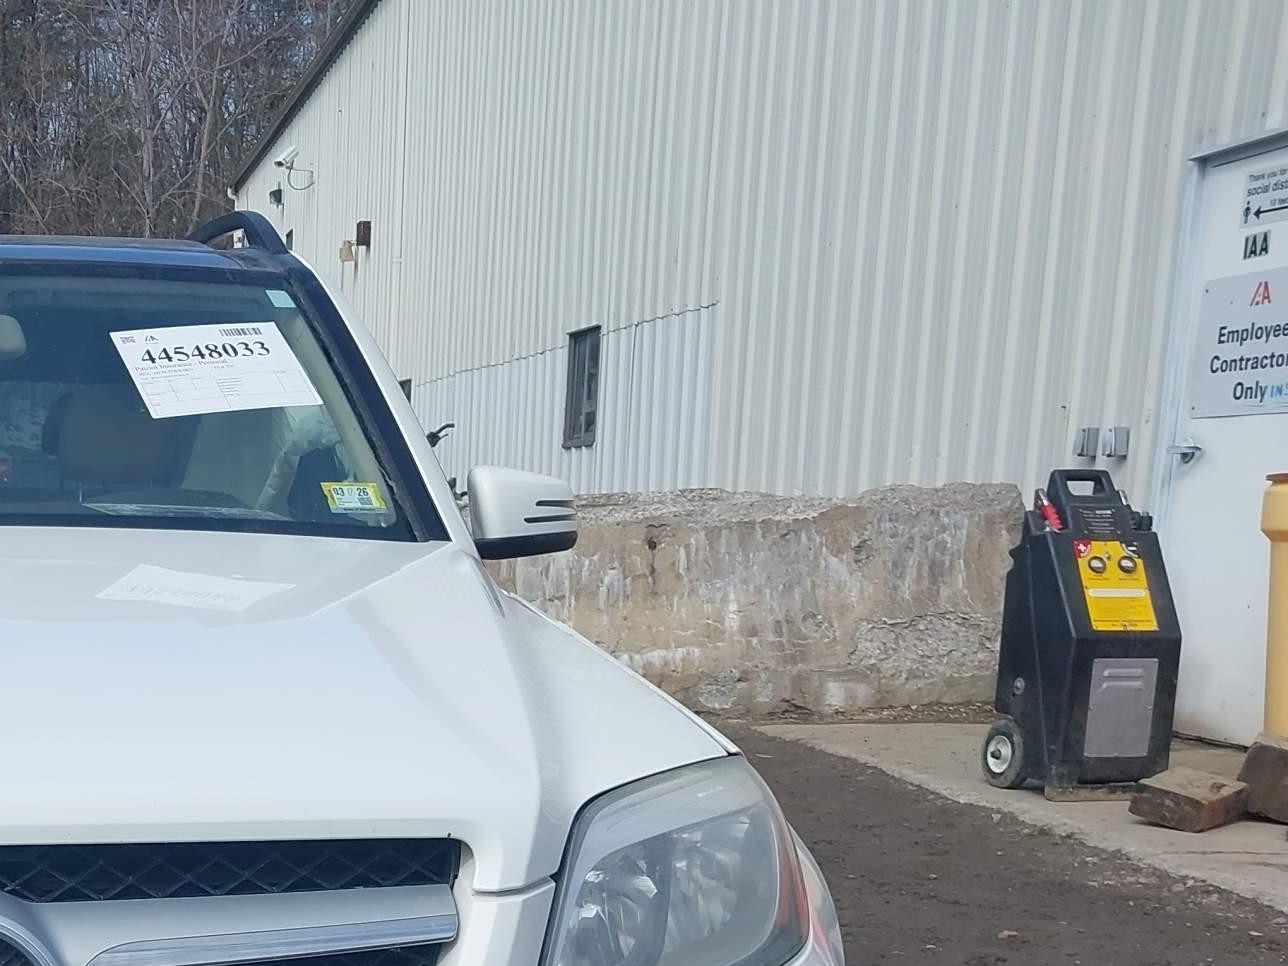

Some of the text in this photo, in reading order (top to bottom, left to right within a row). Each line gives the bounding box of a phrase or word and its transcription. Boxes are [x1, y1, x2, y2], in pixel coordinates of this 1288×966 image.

[1246, 180, 1271, 198] social
[1242, 231, 1270, 260] IAA
[141, 341, 271, 364] 44548033
[1233, 380, 1268, 404] Only
[356, 487, 369, 496] 26
